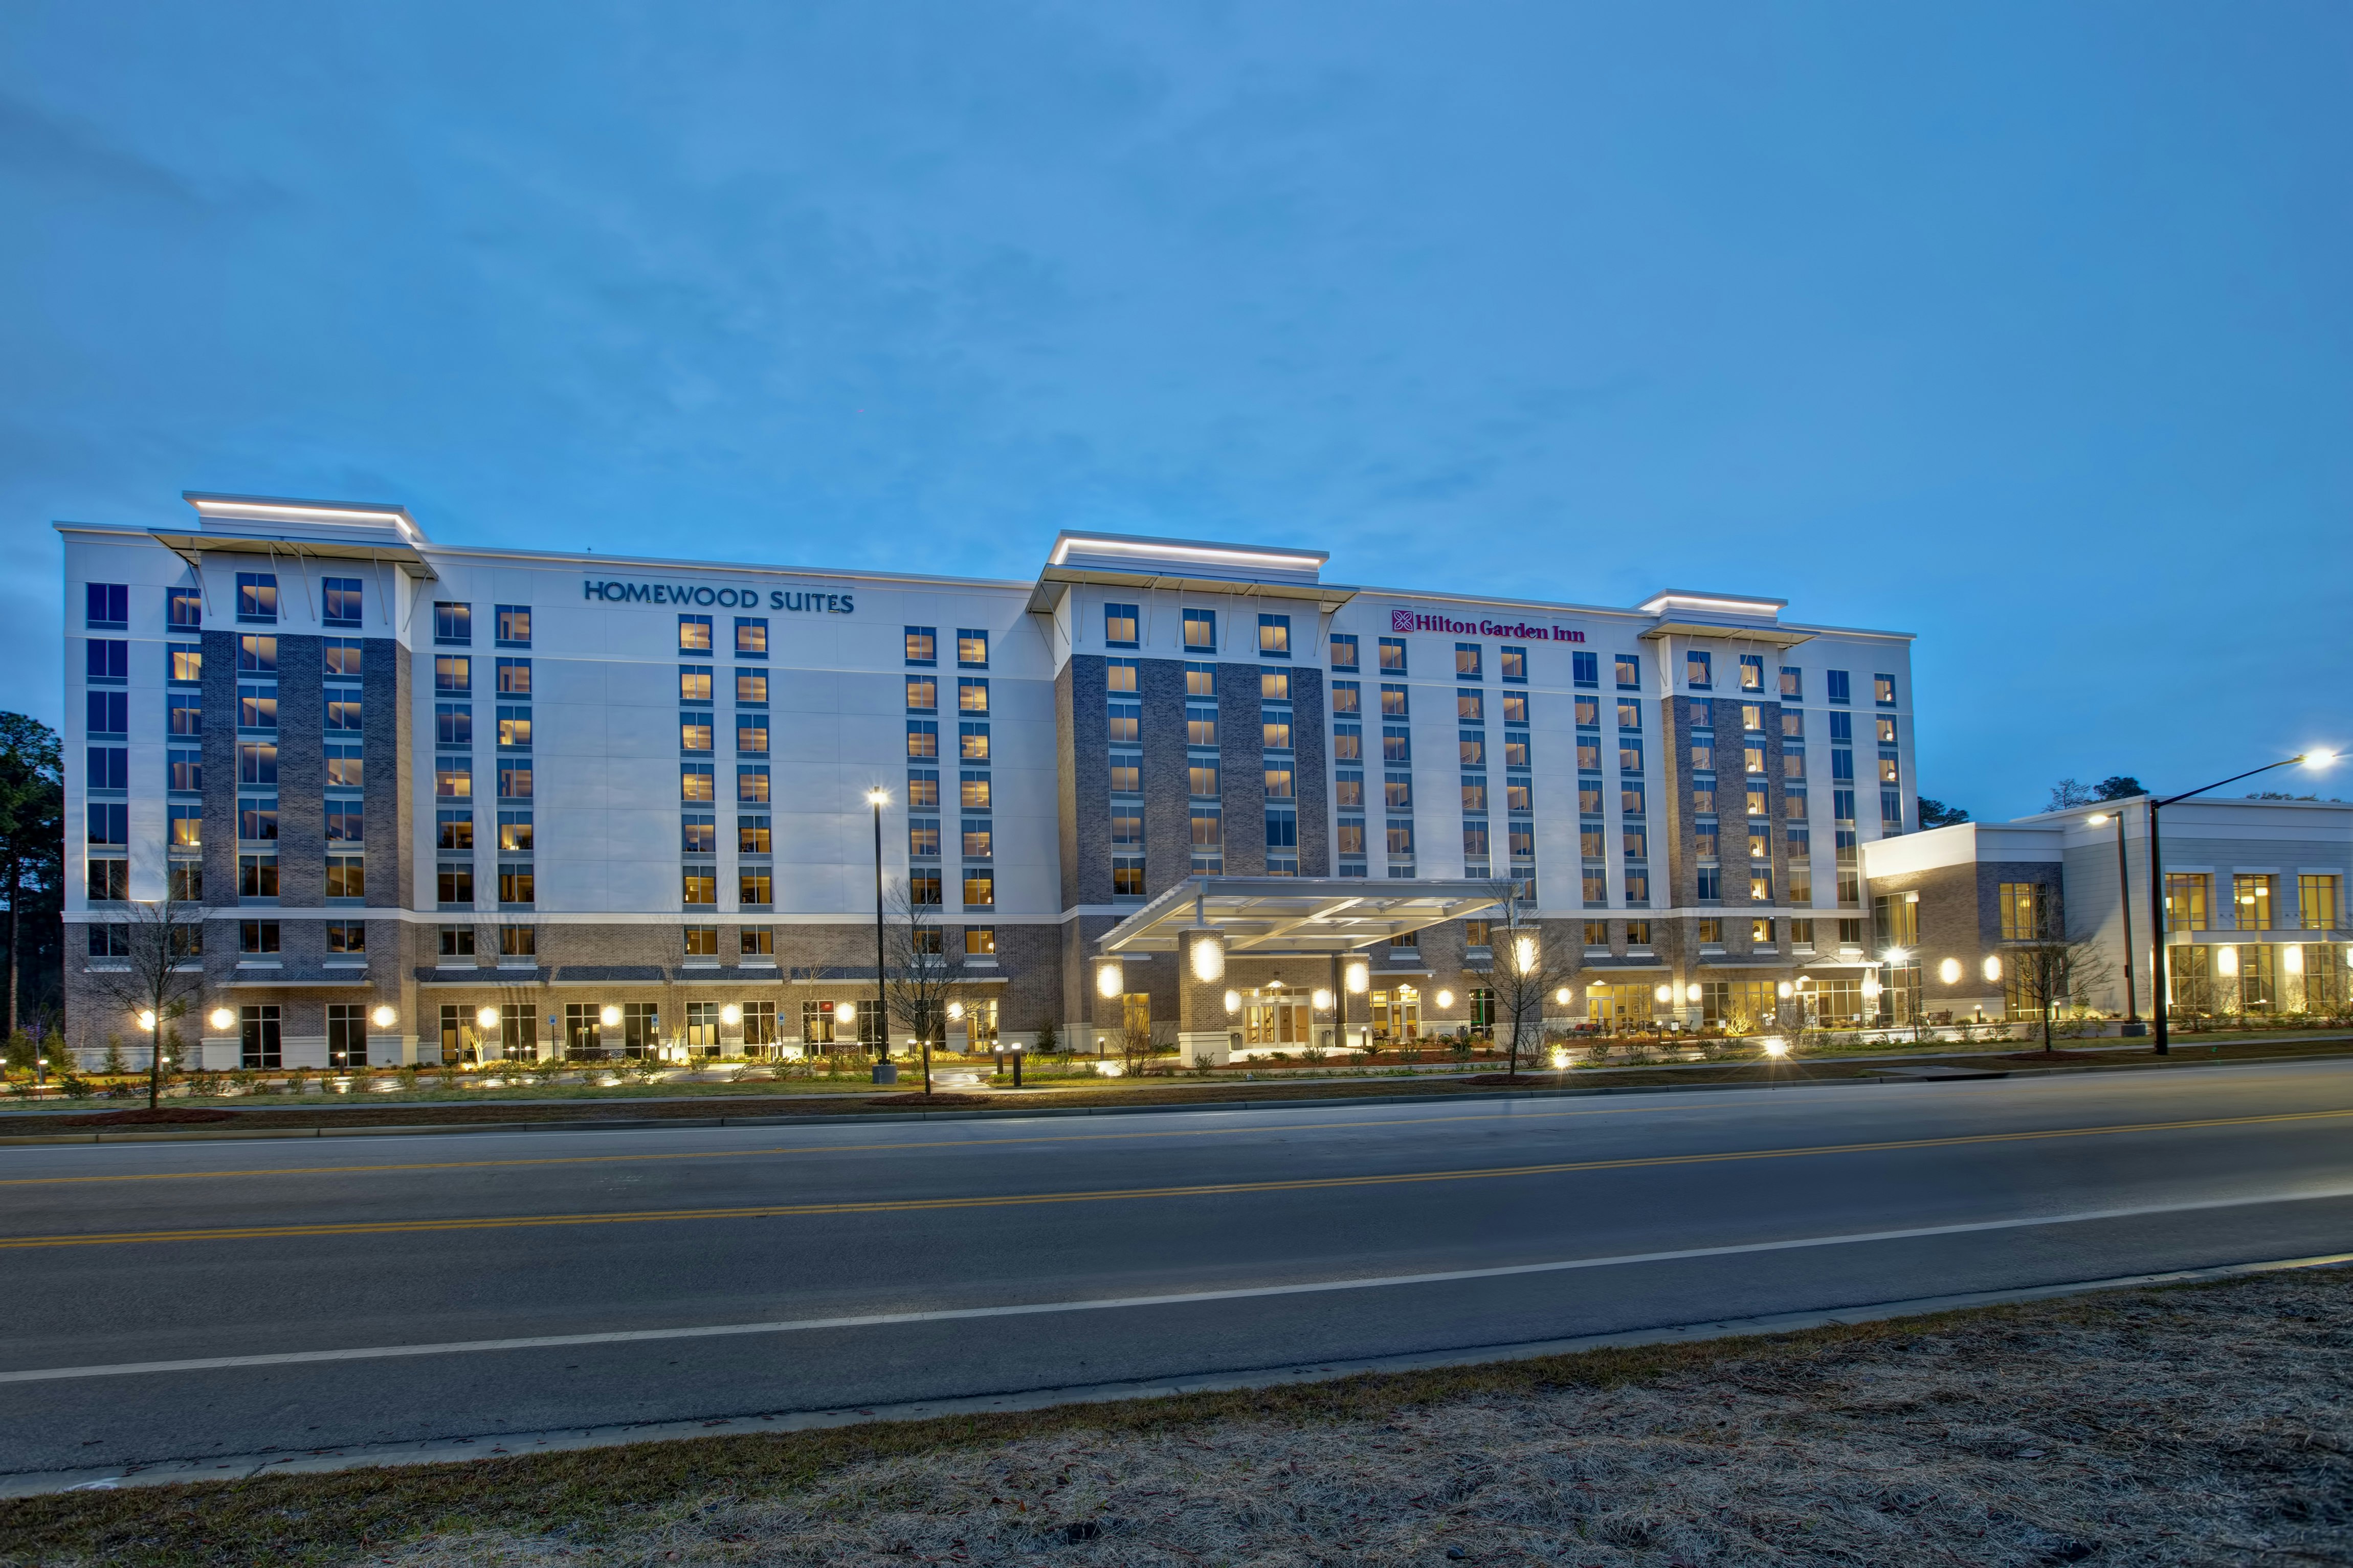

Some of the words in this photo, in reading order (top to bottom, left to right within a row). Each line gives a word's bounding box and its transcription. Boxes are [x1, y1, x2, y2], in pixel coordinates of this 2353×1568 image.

[585, 580, 759, 608] HOMEWOOD
[770, 591, 854, 613] SUITES
[1415, 614, 1477, 635] Hilton
[1480, 620, 1549, 640] Garden
[1552, 625, 1586, 643] Inn
